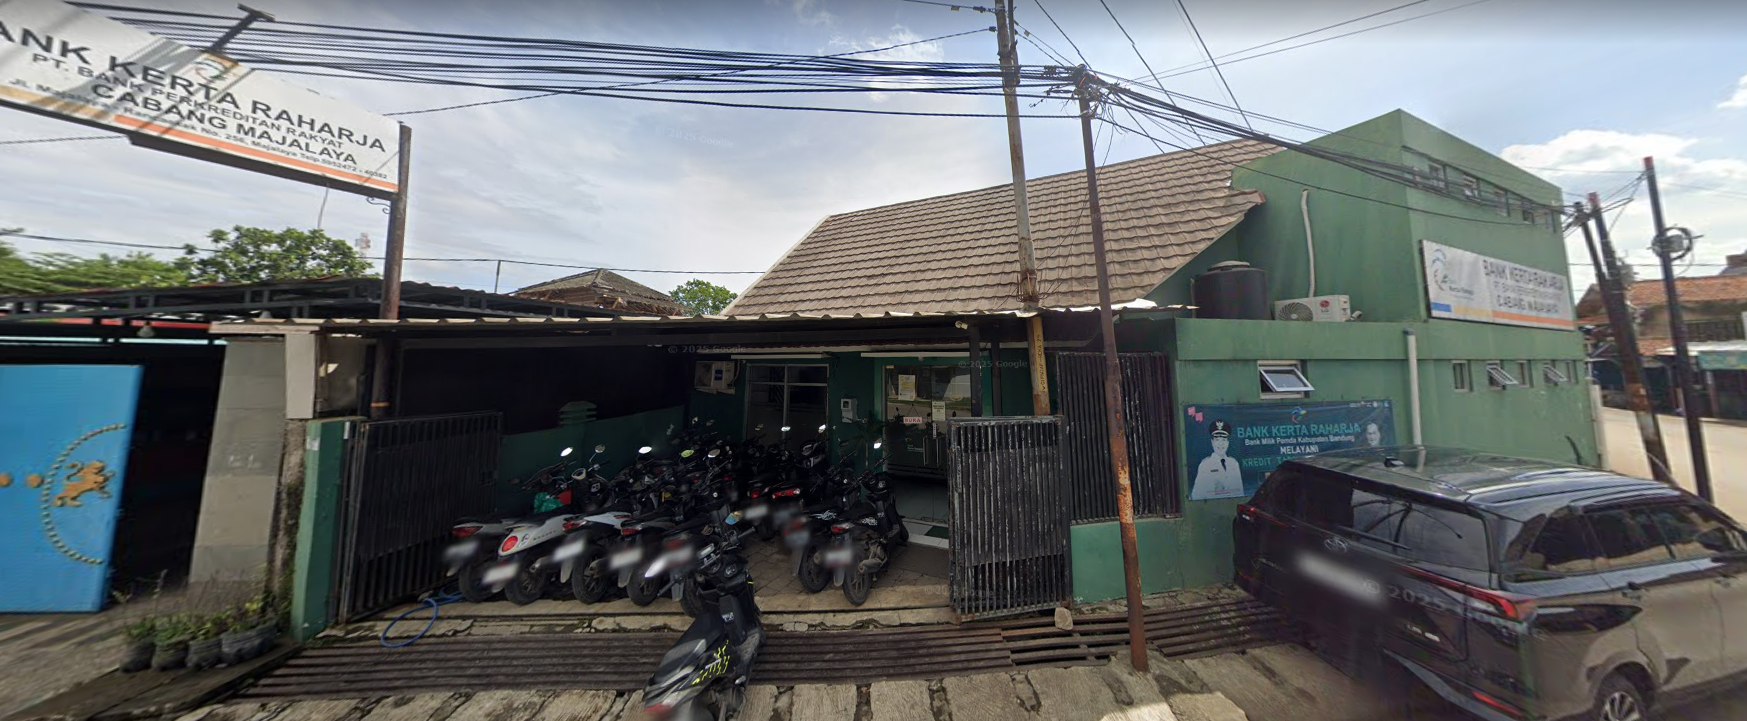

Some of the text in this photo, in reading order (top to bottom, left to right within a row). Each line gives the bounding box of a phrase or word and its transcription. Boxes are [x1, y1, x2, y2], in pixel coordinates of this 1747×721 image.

[0, 19, 386, 153] ANK KERTA RAHARJA
[32, 52, 344, 149] PT. BANK PERKREDITAN RAKYAT
[91, 83, 357, 165] CABANG MAJALAYA
[200, 127, 222, 138] No.
[250, 140, 298, 156] Majalaya
[1237, 422, 1361, 438] BANK KERTA RAHARJA
[1244, 438, 1260, 446] Bank
[1280, 445, 1319, 454] MELAYANI
[1242, 457, 1271, 467] KREDIT
